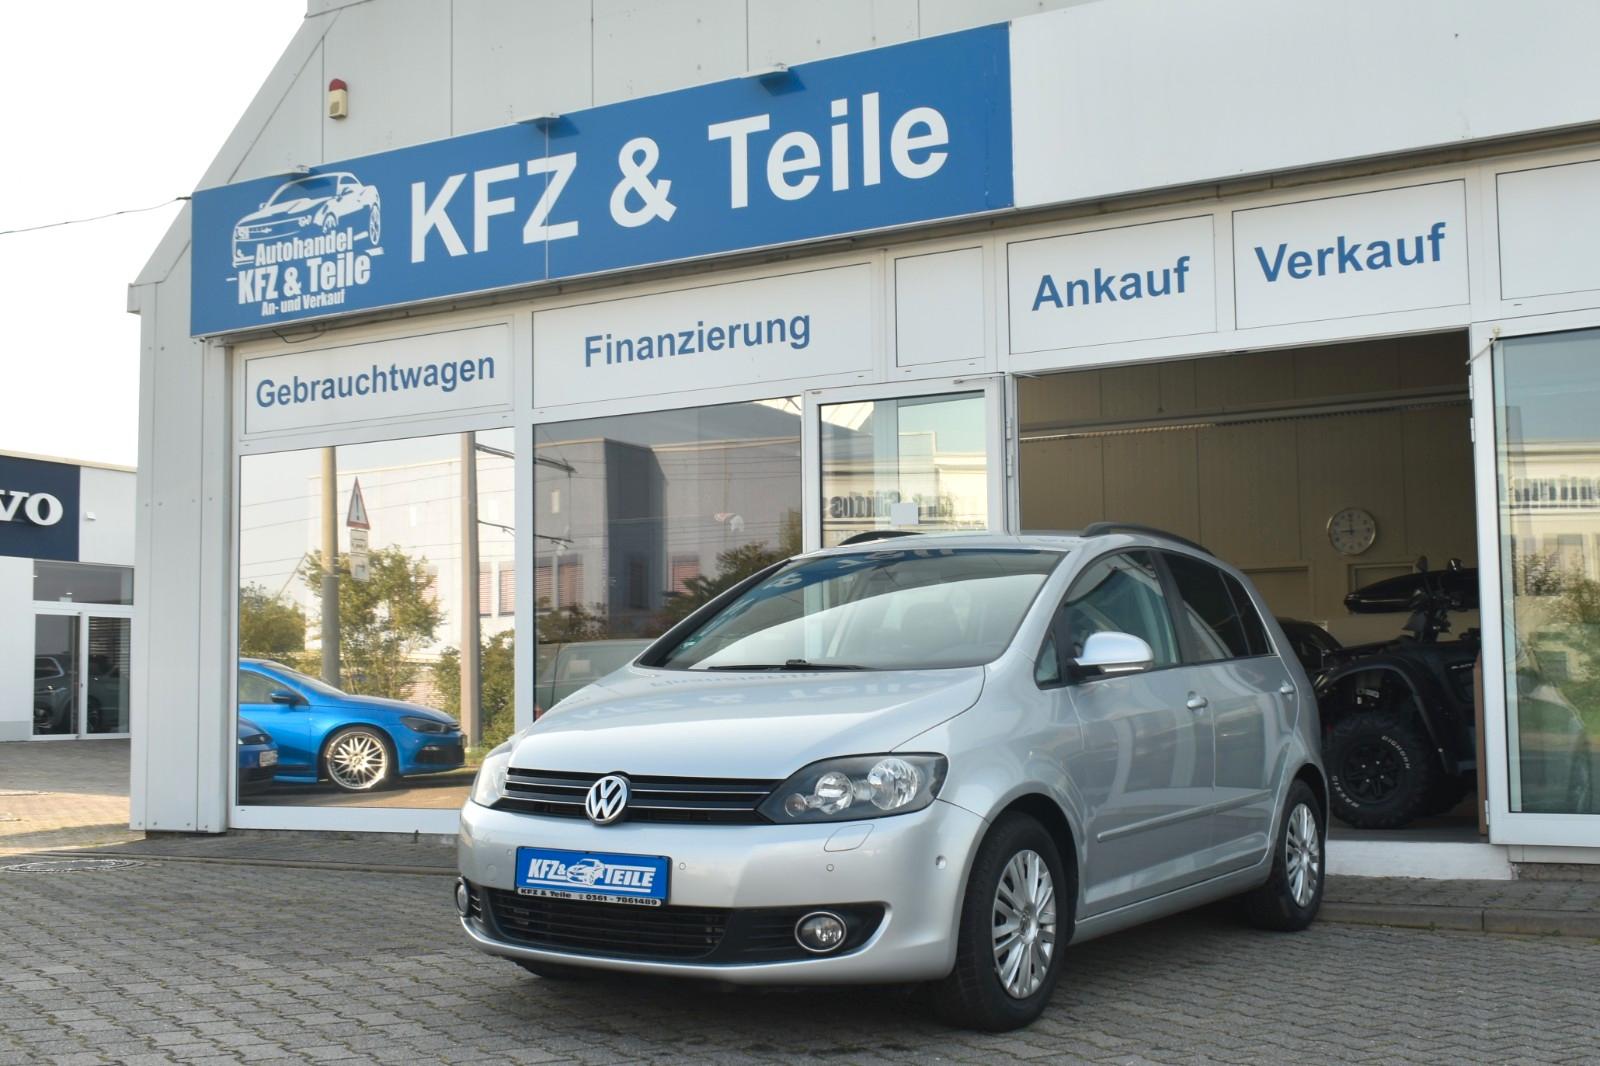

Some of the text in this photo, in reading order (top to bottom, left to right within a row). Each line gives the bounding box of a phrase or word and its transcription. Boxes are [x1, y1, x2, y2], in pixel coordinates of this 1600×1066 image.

[411, 92, 949, 263] KFZ & Teile
[256, 227, 353, 266] Autohandel
[1254, 222, 1446, 283] Verkauf
[238, 252, 371, 304] KFZ & Teile
[261, 289, 345, 316] An- und Verkauf
[1031, 256, 1191, 311] Ankauf
[585, 314, 811, 367] Finanzierung
[256, 356, 495, 408] Gebrauchtwagen
[586, 776, 627, 821] VW
[550, 889, 572, 898] Teile
[604, 864, 656, 887] TEILE
